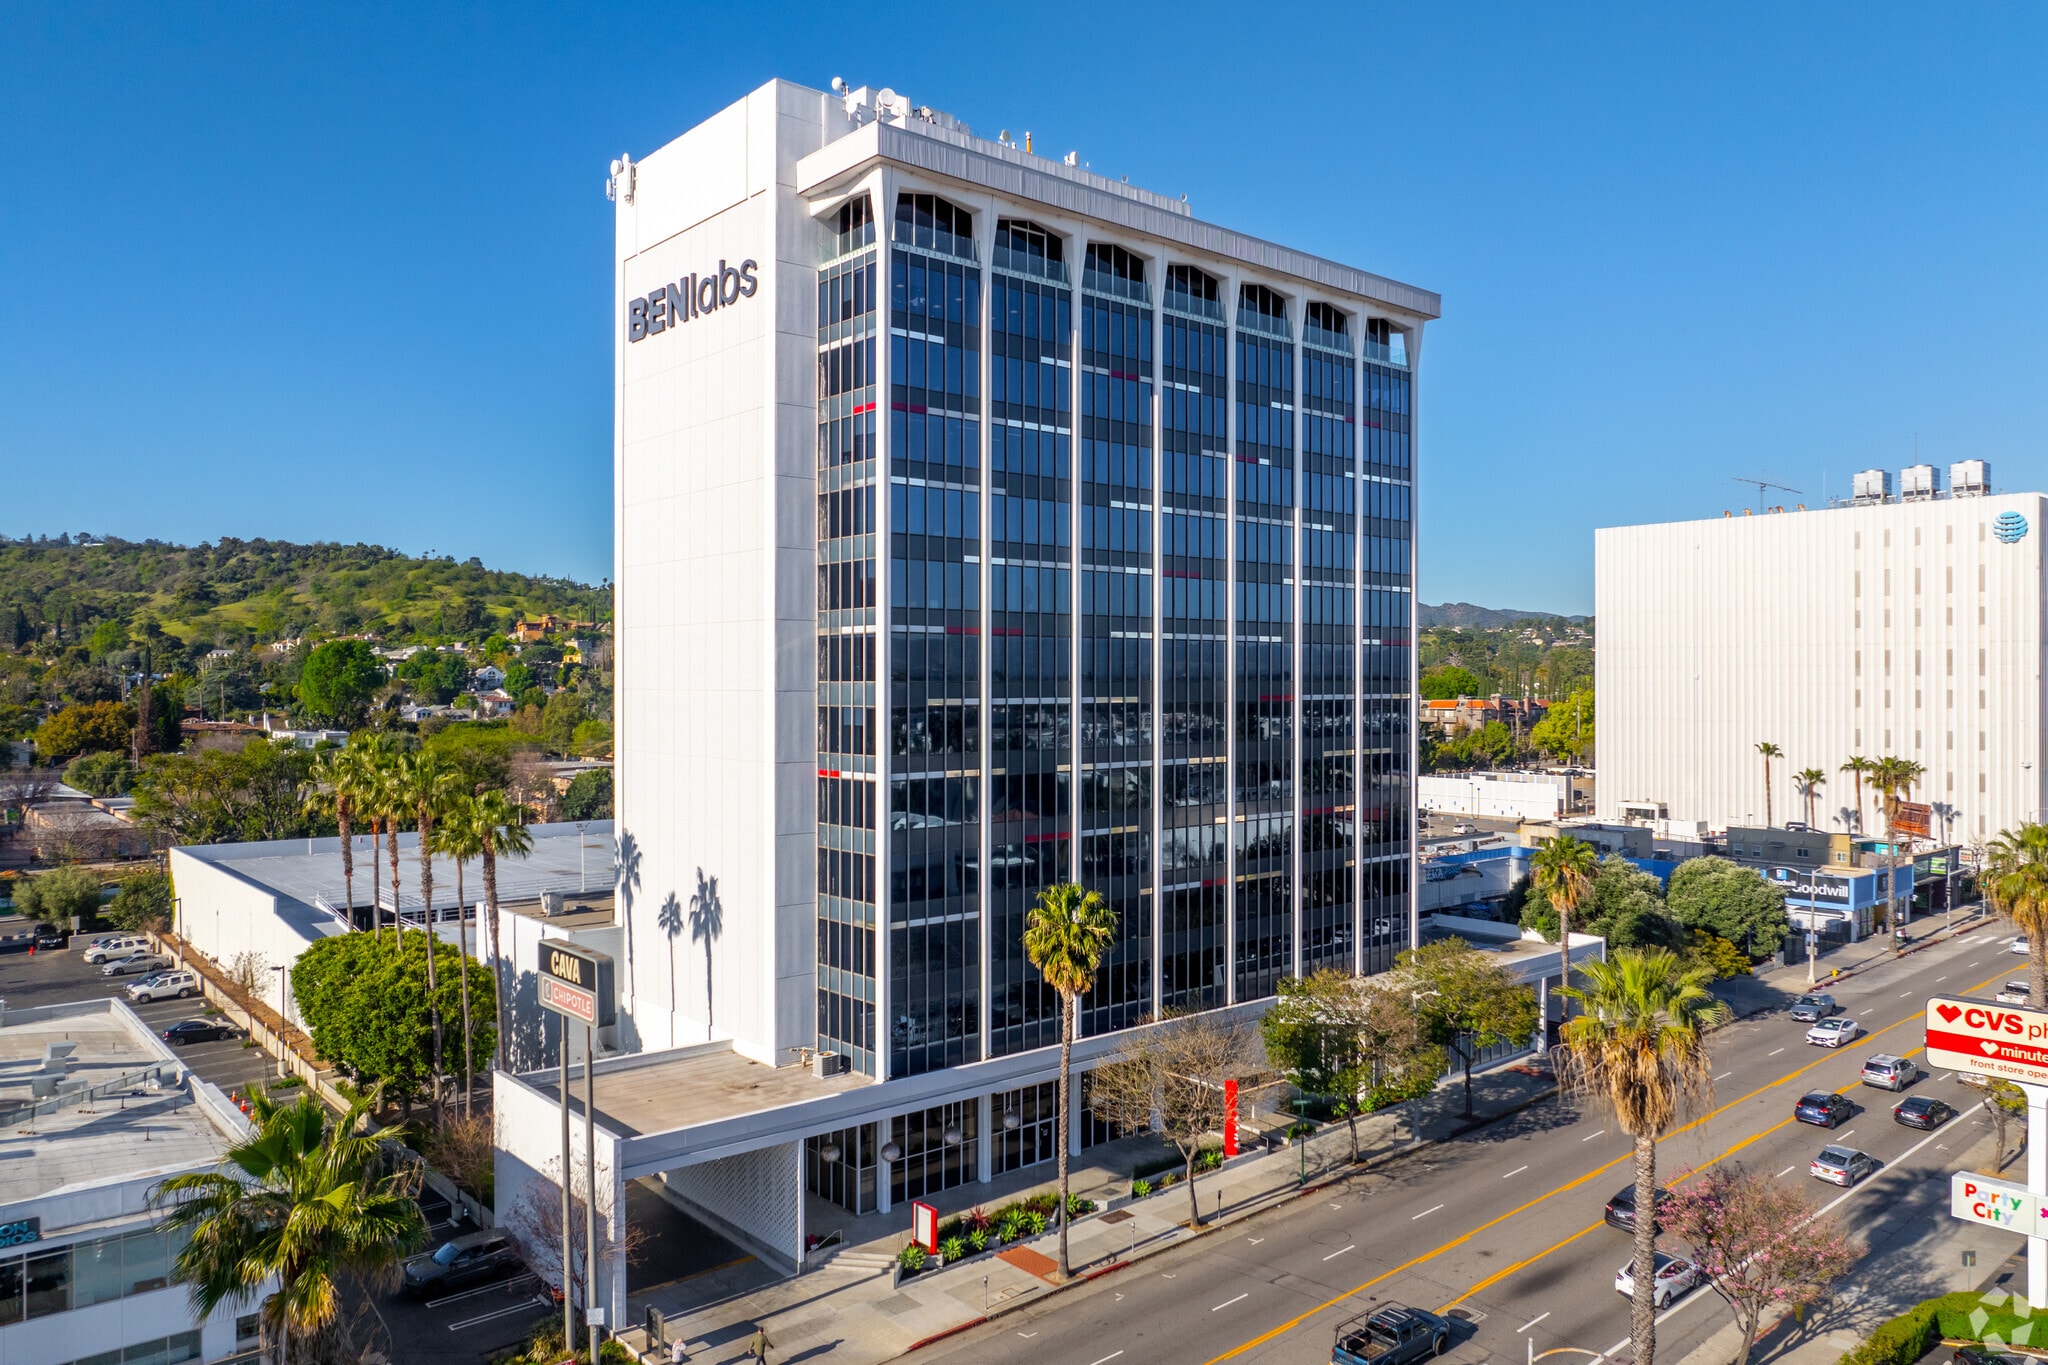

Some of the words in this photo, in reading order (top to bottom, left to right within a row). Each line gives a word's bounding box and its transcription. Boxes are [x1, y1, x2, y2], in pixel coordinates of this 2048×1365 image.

[628, 259, 757, 343] BENlabs
[550, 950, 581, 985] CAVA
[553, 987, 591, 1014] CHIPOTLE
[1964, 1008, 2024, 1034] CVS
[1970, 1058, 1995, 1071] front
[1997, 1063, 2025, 1075] store
[1965, 1182, 2022, 1211] Party
[1973, 1202, 2014, 1226] City
